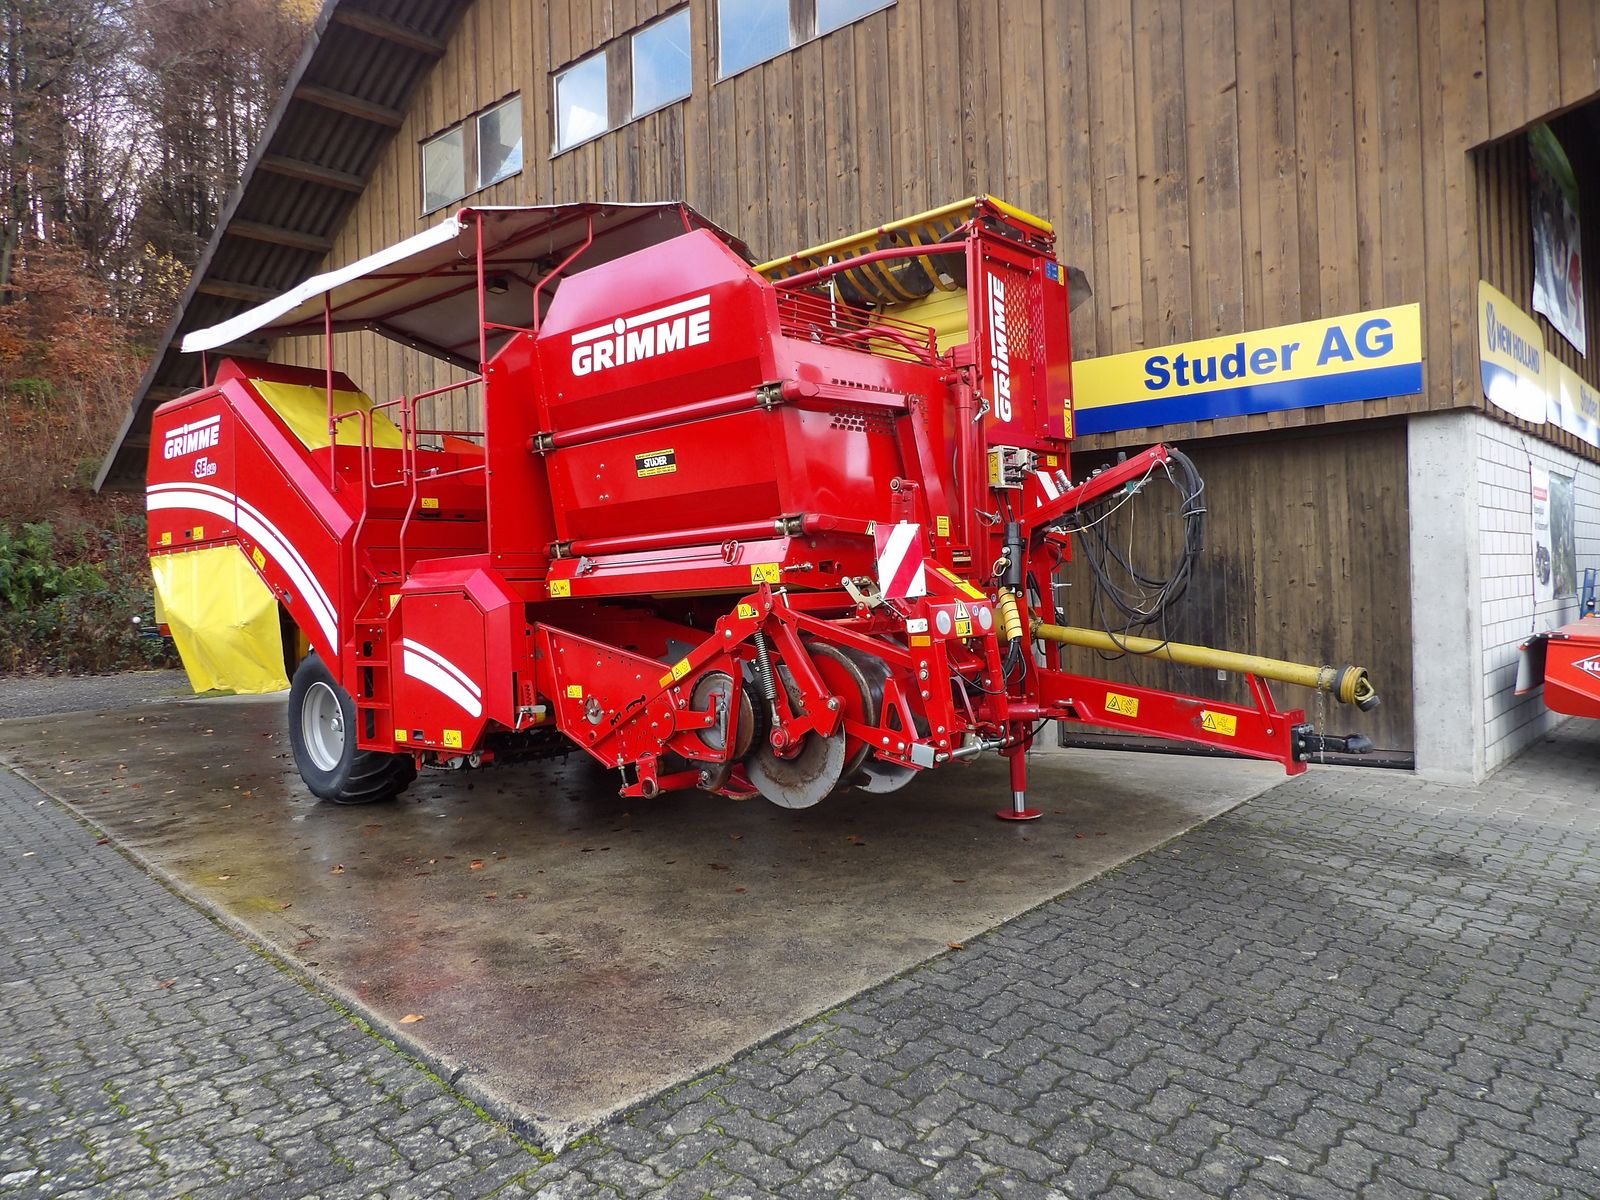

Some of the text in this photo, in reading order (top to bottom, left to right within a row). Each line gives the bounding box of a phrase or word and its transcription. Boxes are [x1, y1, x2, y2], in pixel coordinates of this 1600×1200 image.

[1144, 318, 1394, 391] Studer AG
[1496, 320, 1540, 374] NEW HOLLAND
[643, 456, 668, 468] STUDER
